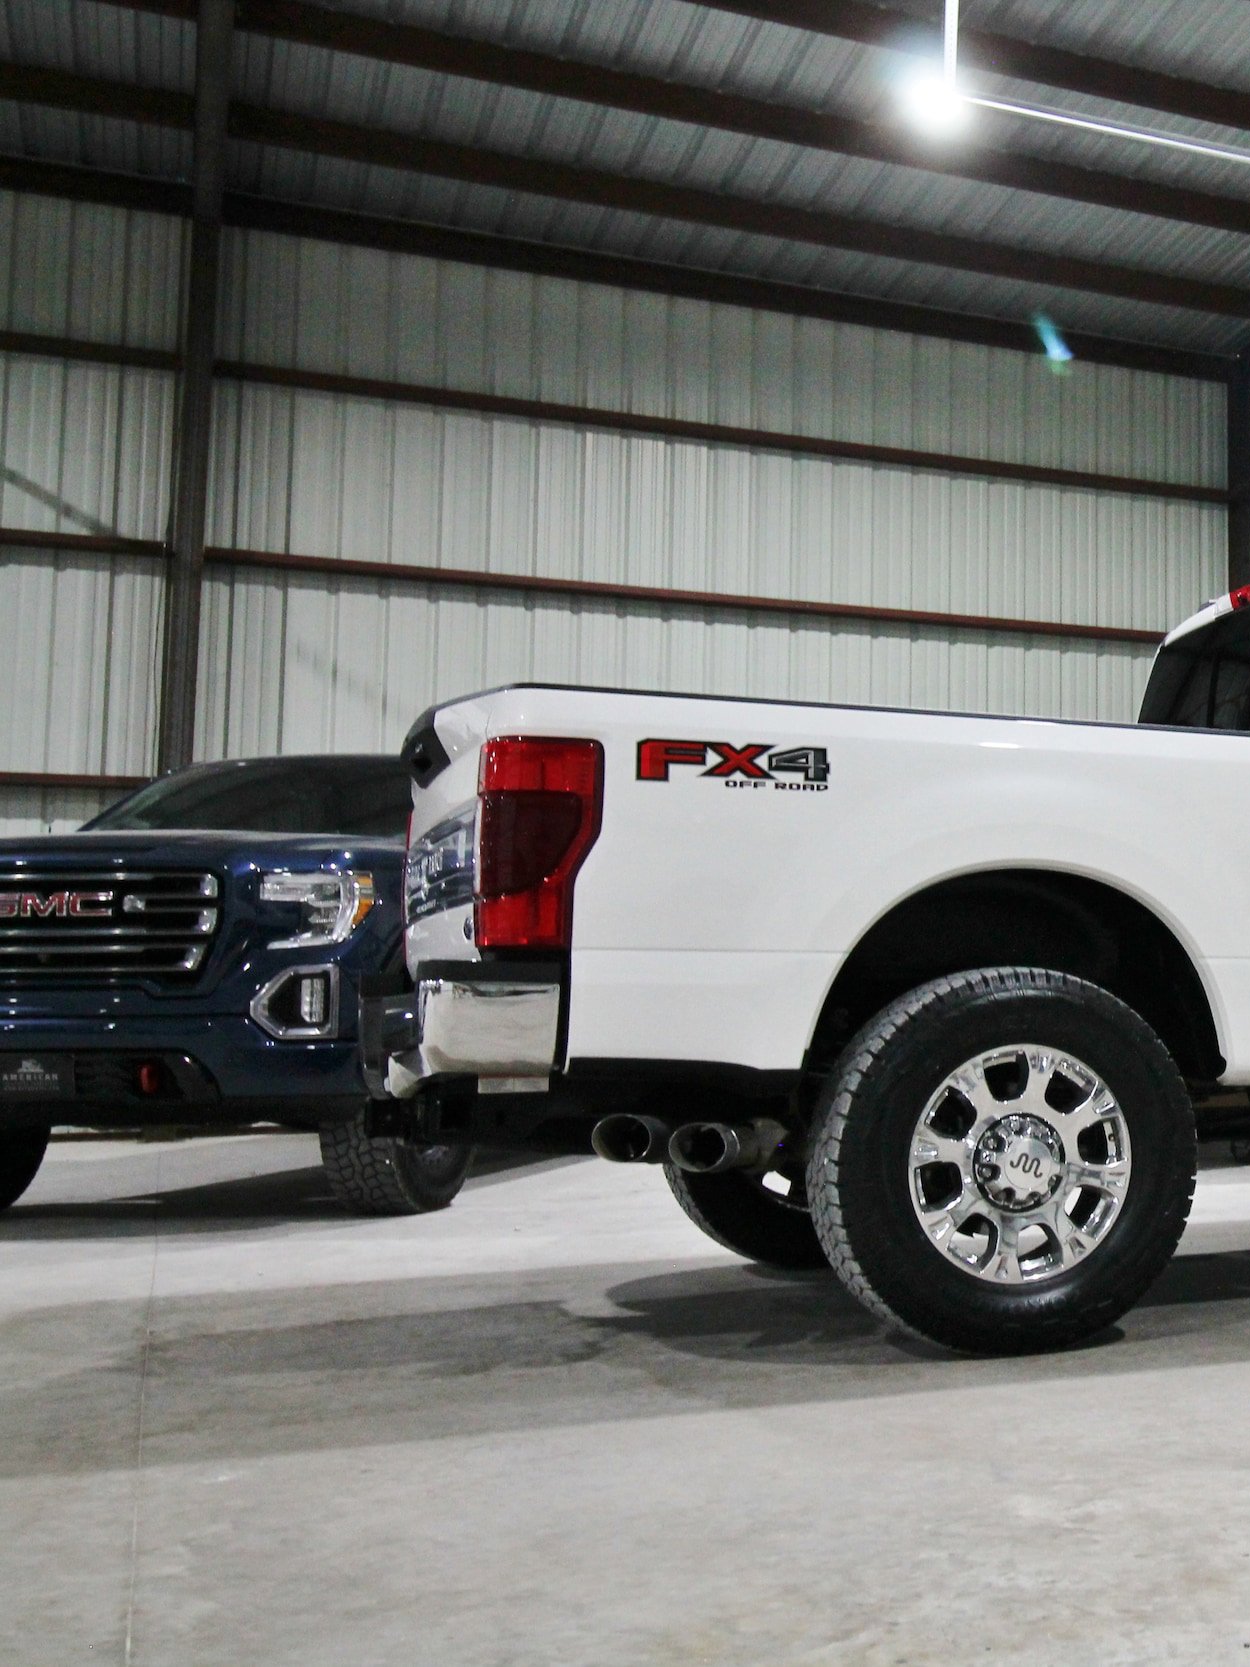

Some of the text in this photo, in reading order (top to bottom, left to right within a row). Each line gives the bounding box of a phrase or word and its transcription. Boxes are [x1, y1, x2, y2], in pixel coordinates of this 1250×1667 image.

[636, 738, 830, 782] FX4
[725, 780, 829, 791] OFF ROAD
